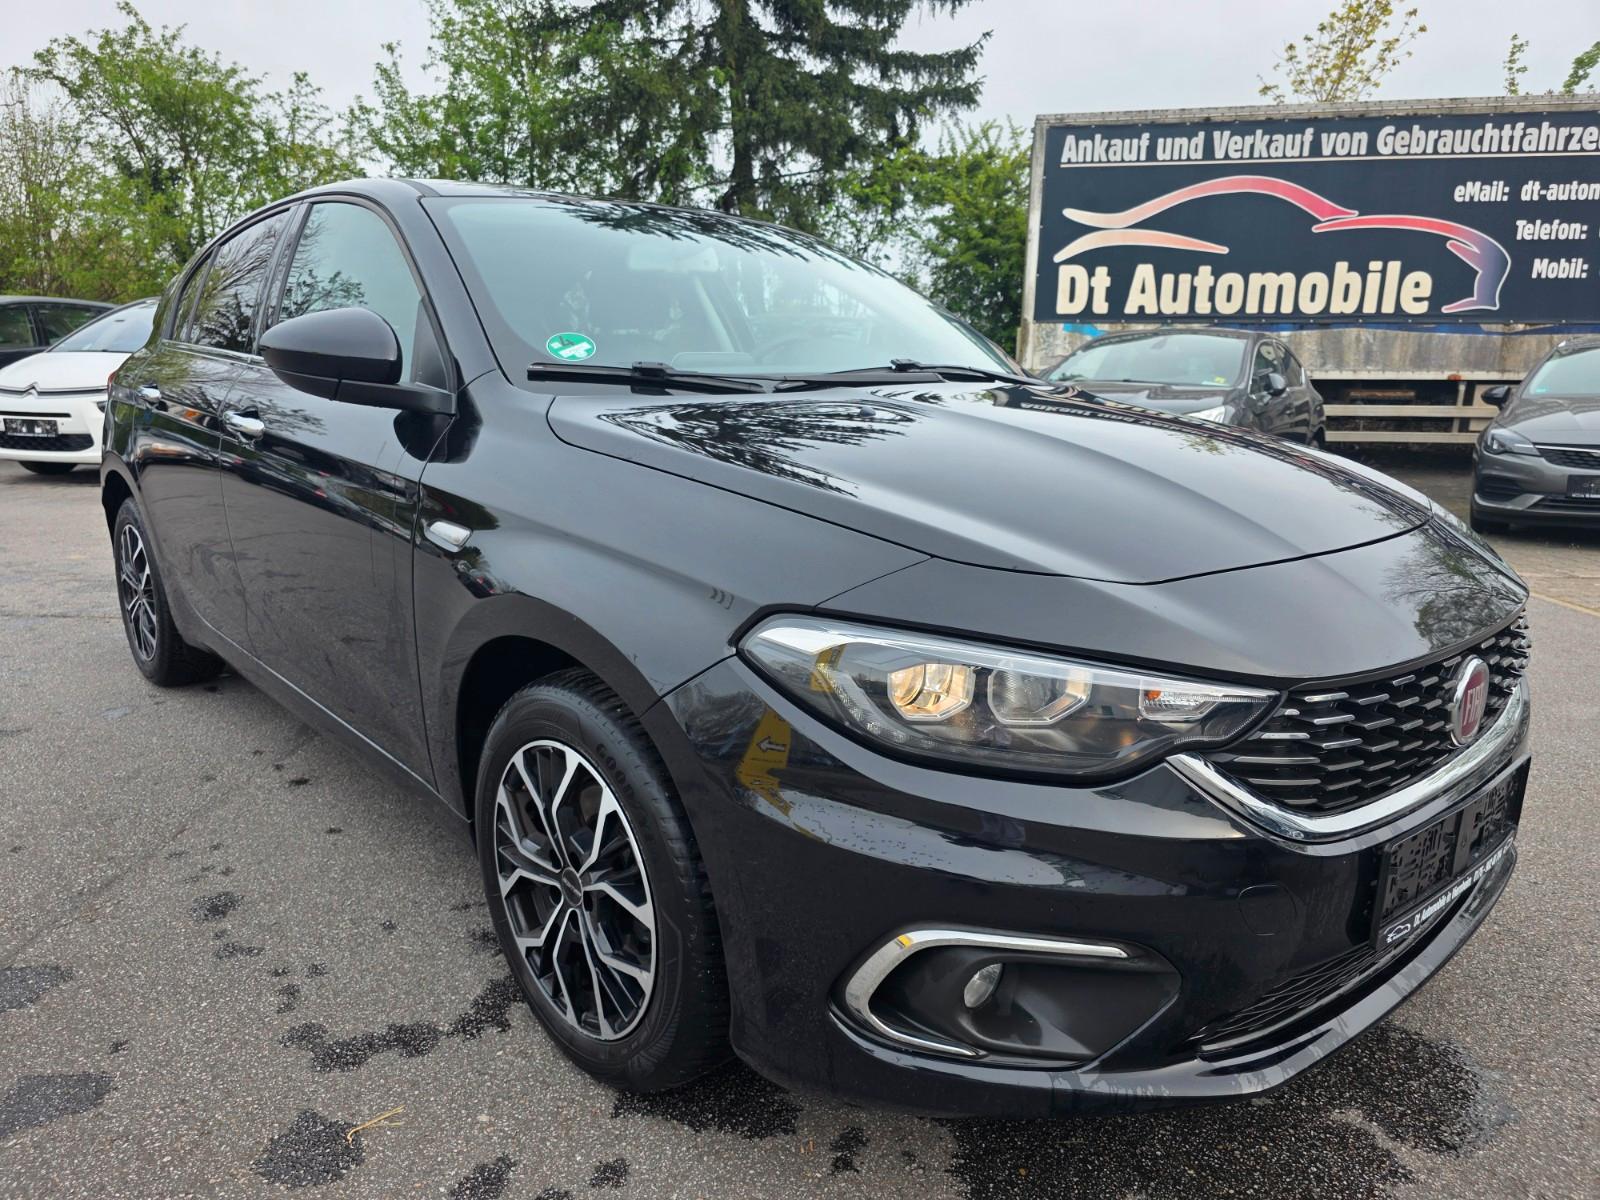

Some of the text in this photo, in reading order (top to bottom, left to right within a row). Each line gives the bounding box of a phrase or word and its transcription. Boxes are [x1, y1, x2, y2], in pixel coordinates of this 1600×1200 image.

[1060, 121, 1600, 163] Ankauf und Verkauf von Gebrauchtfahrze
[1454, 180, 1510, 202] eMail:
[1515, 219, 1588, 240] Telefon:
[1531, 258, 1589, 279] Mobil:
[1055, 260, 1433, 315] Dt Automobile
